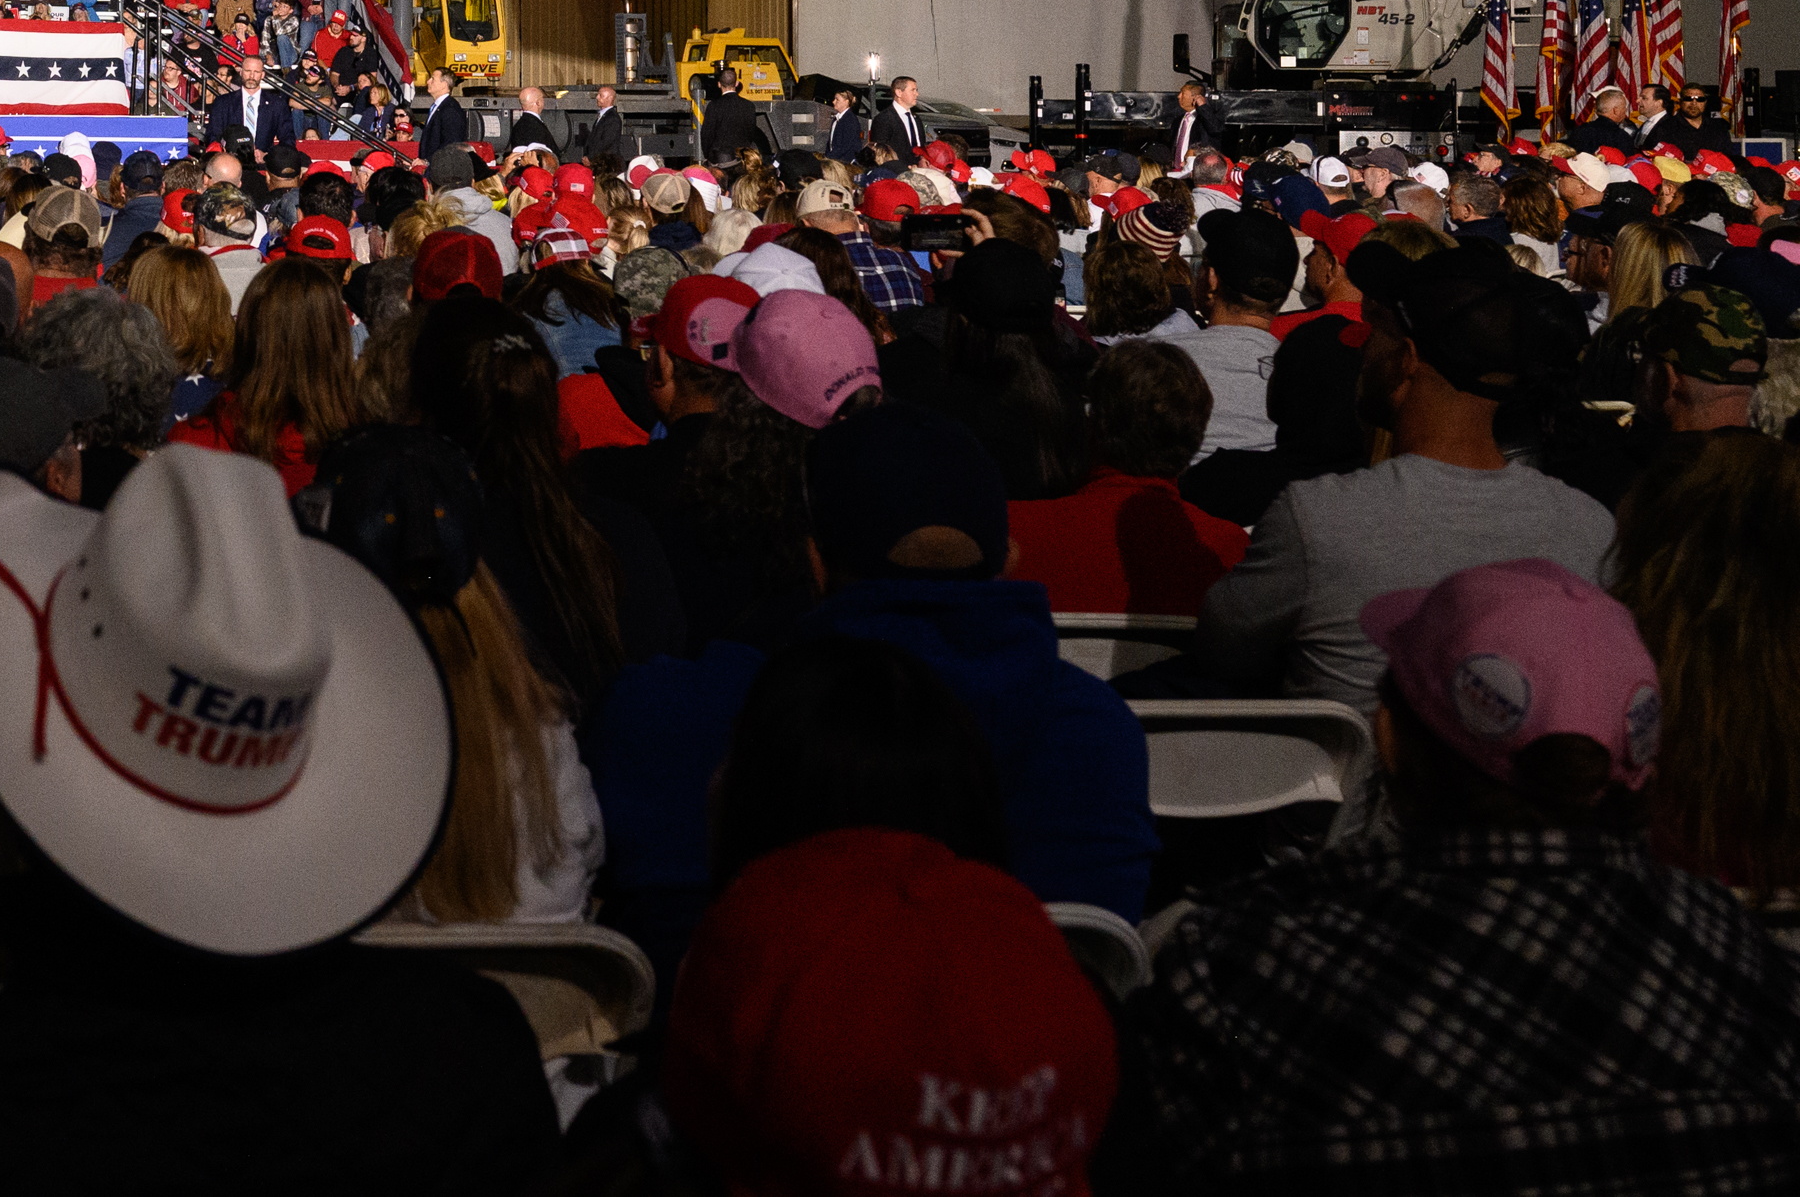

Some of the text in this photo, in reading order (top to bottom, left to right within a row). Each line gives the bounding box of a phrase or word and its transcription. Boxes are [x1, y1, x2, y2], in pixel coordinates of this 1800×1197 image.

[1357, 6, 1415, 25] NBT 45-2
[448, 63, 498, 73] GROVE
[303, 227, 324, 235] DONALD
[824, 367, 864, 402] DONALD
[169, 665, 311, 731] TEAM
